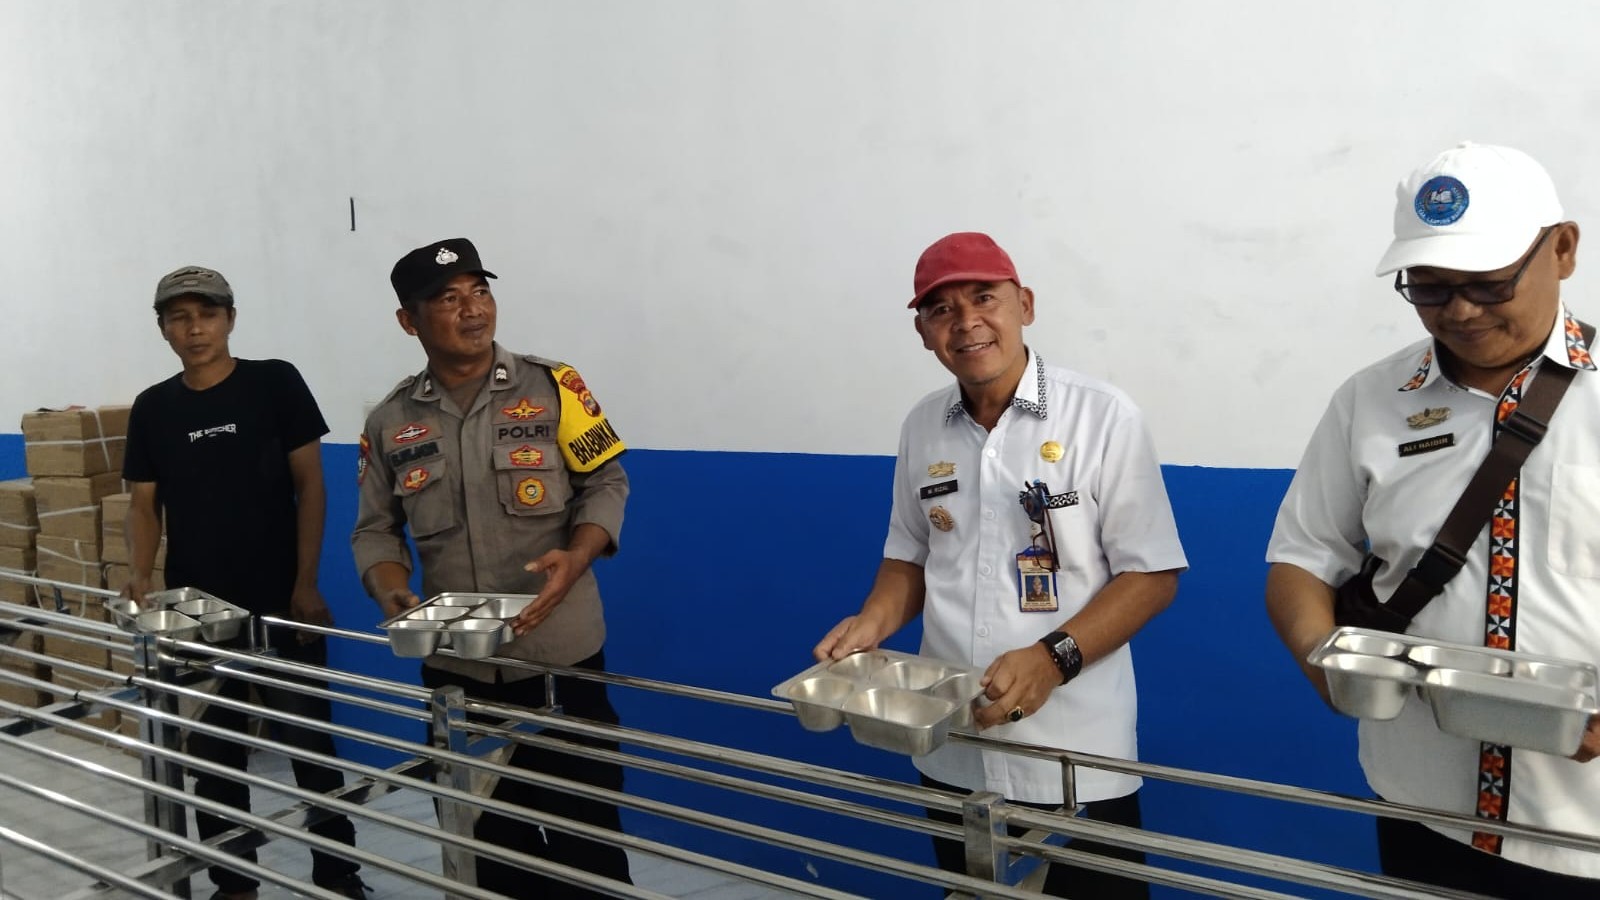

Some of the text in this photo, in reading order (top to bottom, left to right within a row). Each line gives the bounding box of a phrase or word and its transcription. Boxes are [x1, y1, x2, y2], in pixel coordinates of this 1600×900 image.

[188, 430, 204, 443] THE
[498, 424, 550, 440] POLRI
[1403, 444, 1417, 452] ALI
